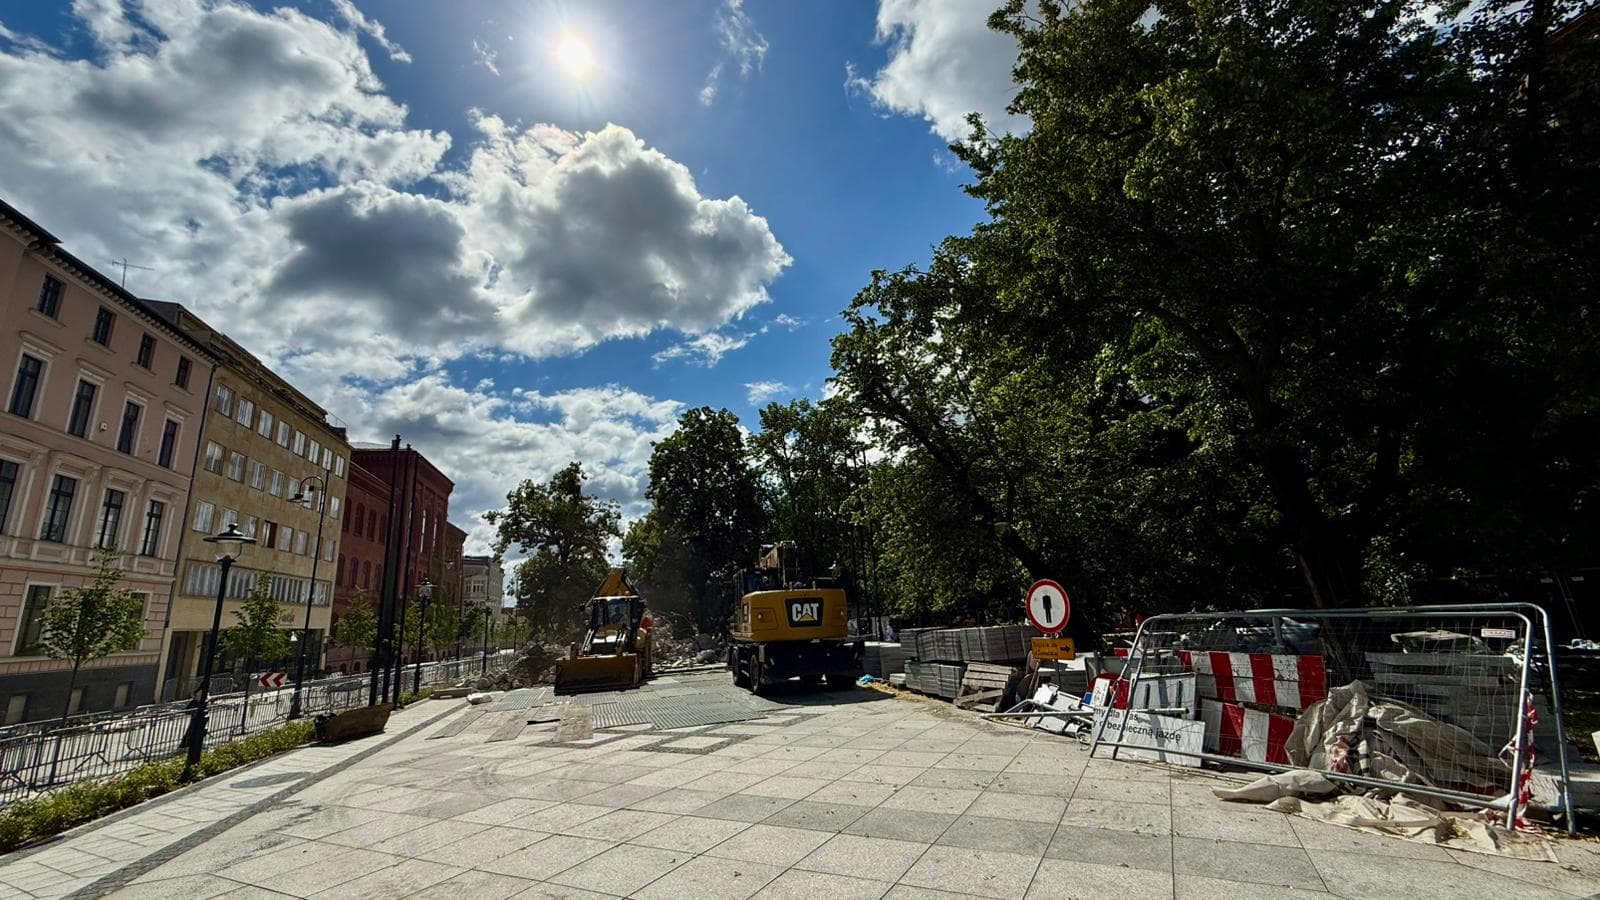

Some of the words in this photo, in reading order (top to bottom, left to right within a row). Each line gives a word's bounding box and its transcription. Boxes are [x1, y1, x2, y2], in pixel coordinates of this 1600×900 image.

[791, 603, 819, 621] CAT
[1108, 708, 1120, 719] dla
[1107, 719, 1153, 739] bezieczną
[1155, 727, 1182, 743] jazdę
